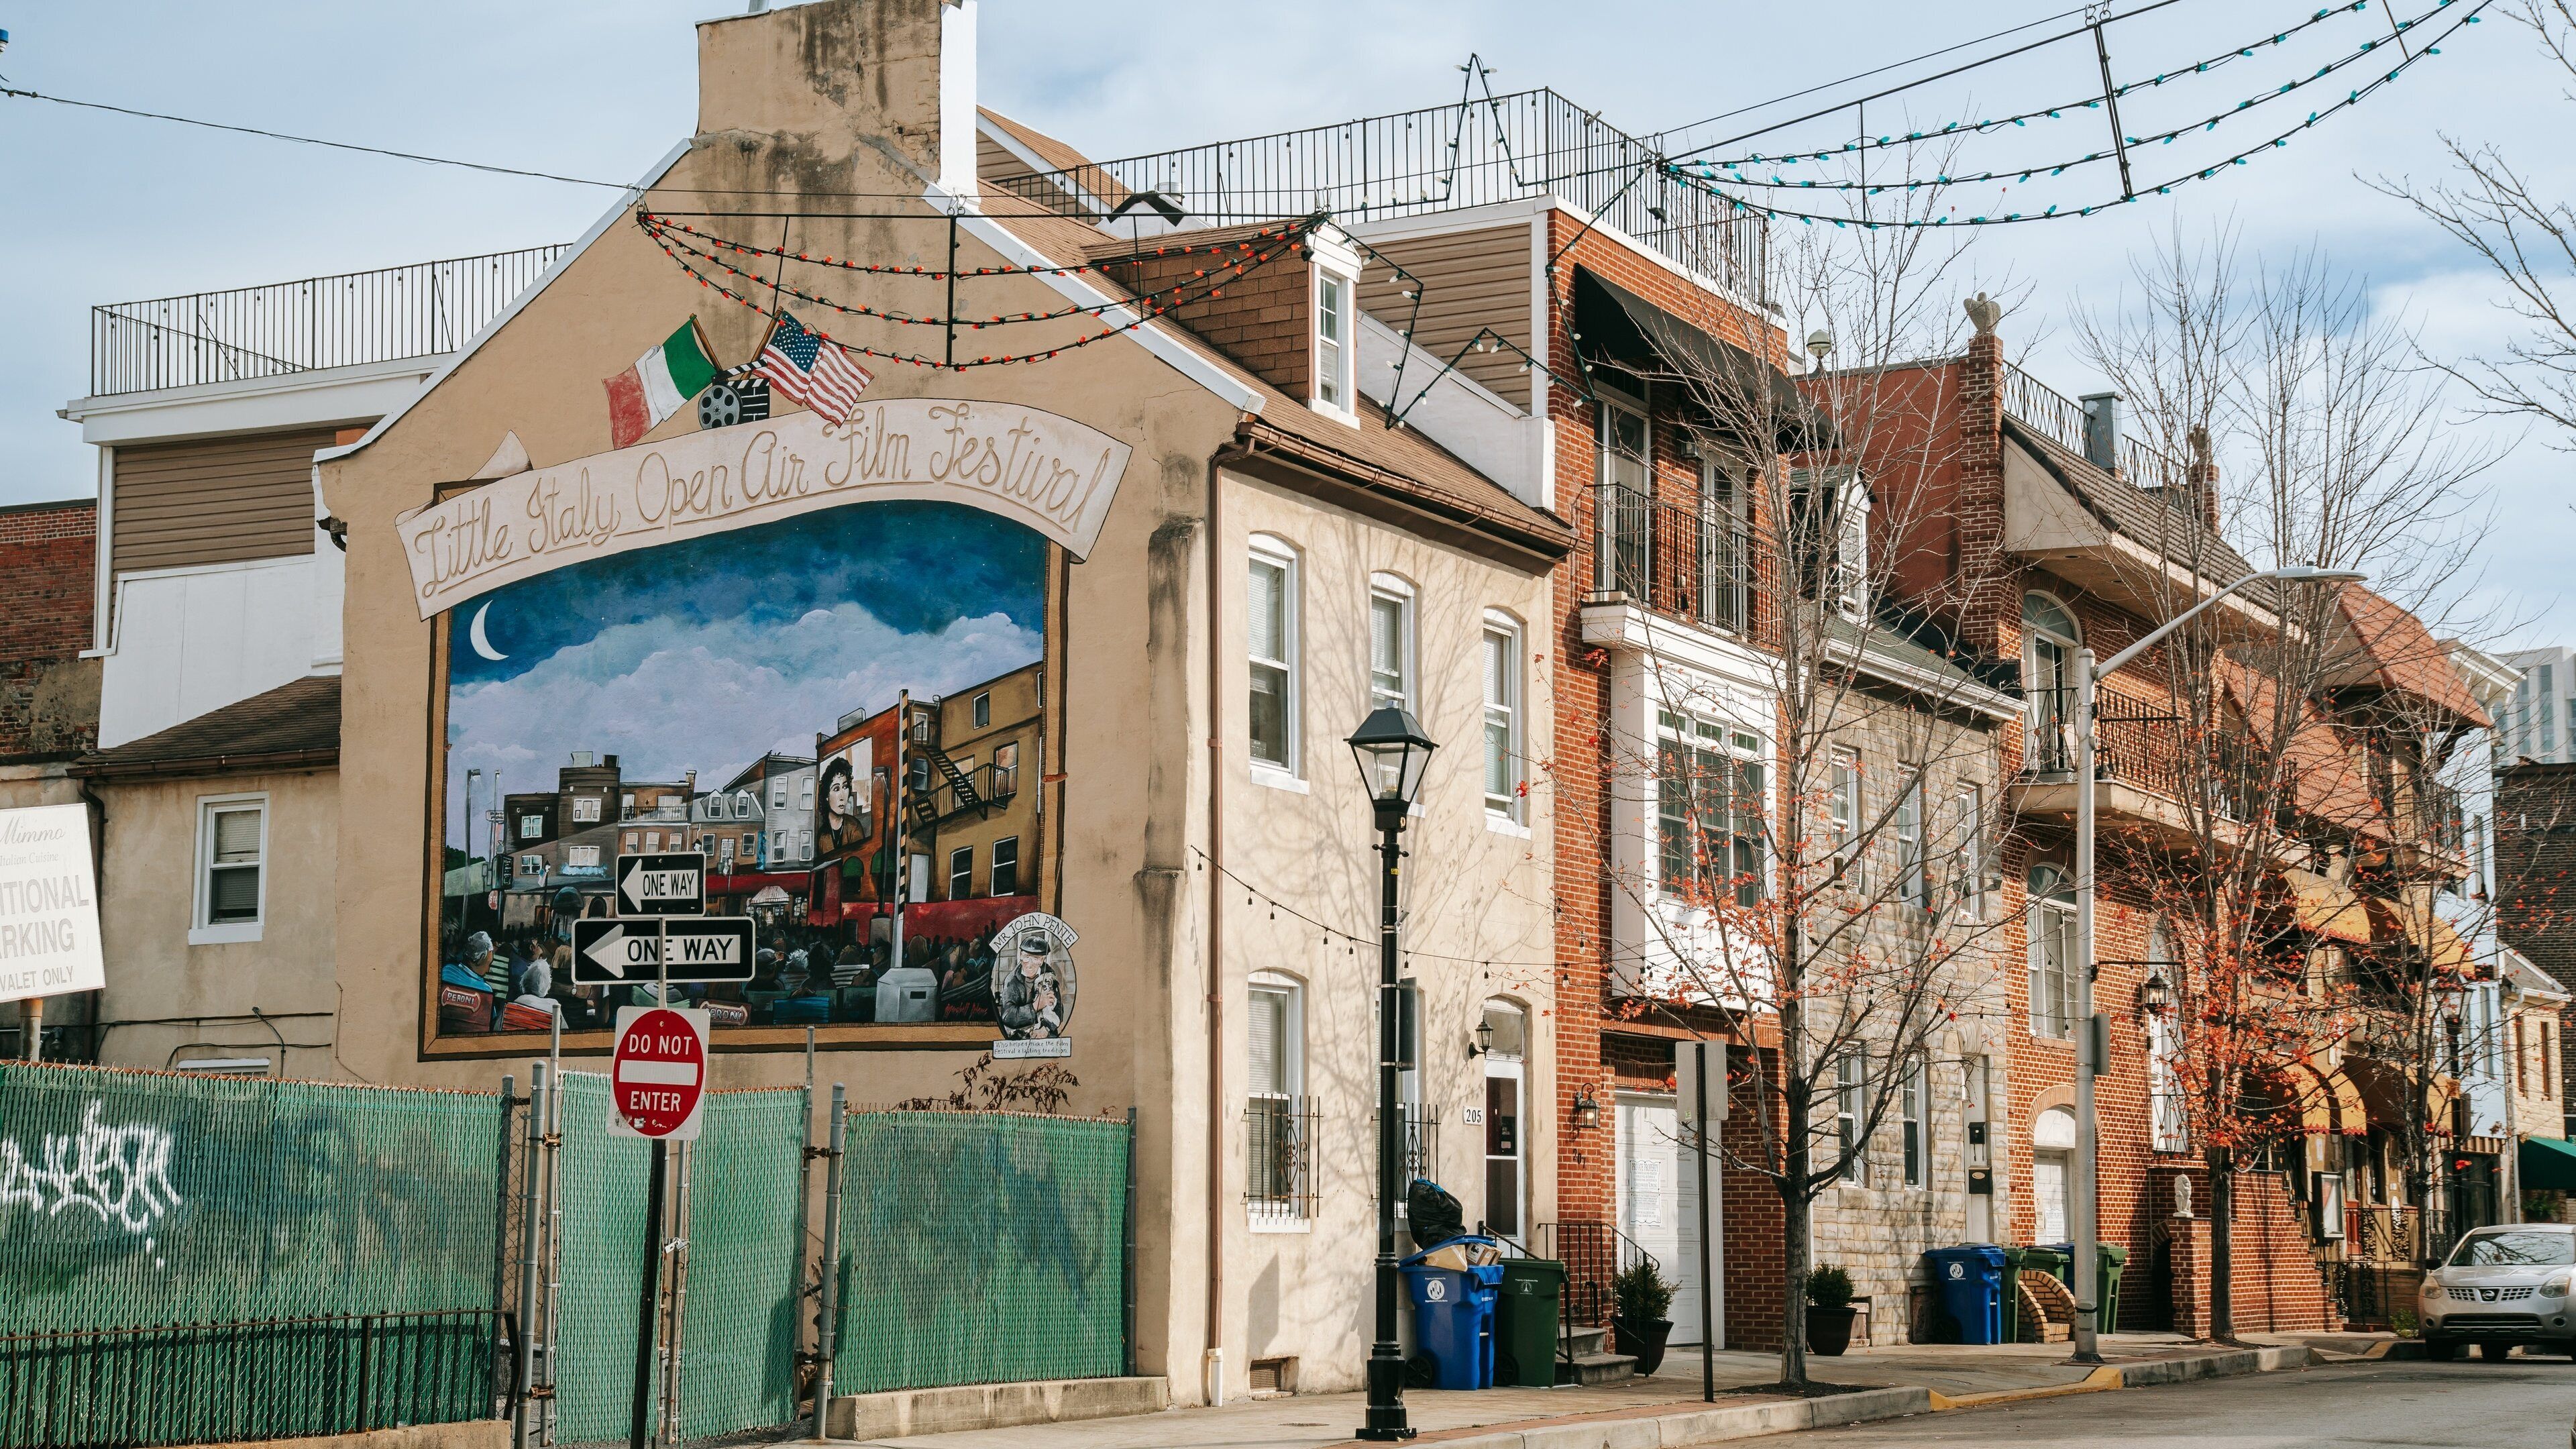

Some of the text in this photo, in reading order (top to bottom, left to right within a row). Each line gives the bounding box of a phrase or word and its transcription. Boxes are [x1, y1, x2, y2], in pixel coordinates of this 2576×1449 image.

[415, 402, 1111, 598] Little Italy Open Air Film Festival
[0, 816, 65, 845] Mimmo
[0, 852, 60, 867] Italian Cuisine
[643, 873, 695, 896] ONE WAY
[0, 918, 75, 959] RKING
[994, 914, 1075, 949] MR JOHN PENTE
[627, 938, 734, 963] ONE WAY
[0, 965, 74, 992] VALET ONLY
[446, 991, 475, 1005] PERONI
[629, 1034, 692, 1055] DO NOT
[630, 1091, 681, 1112] ENTER
[1466, 1109, 1481, 1123] 205
[1572, 1148, 1586, 1168] 207
